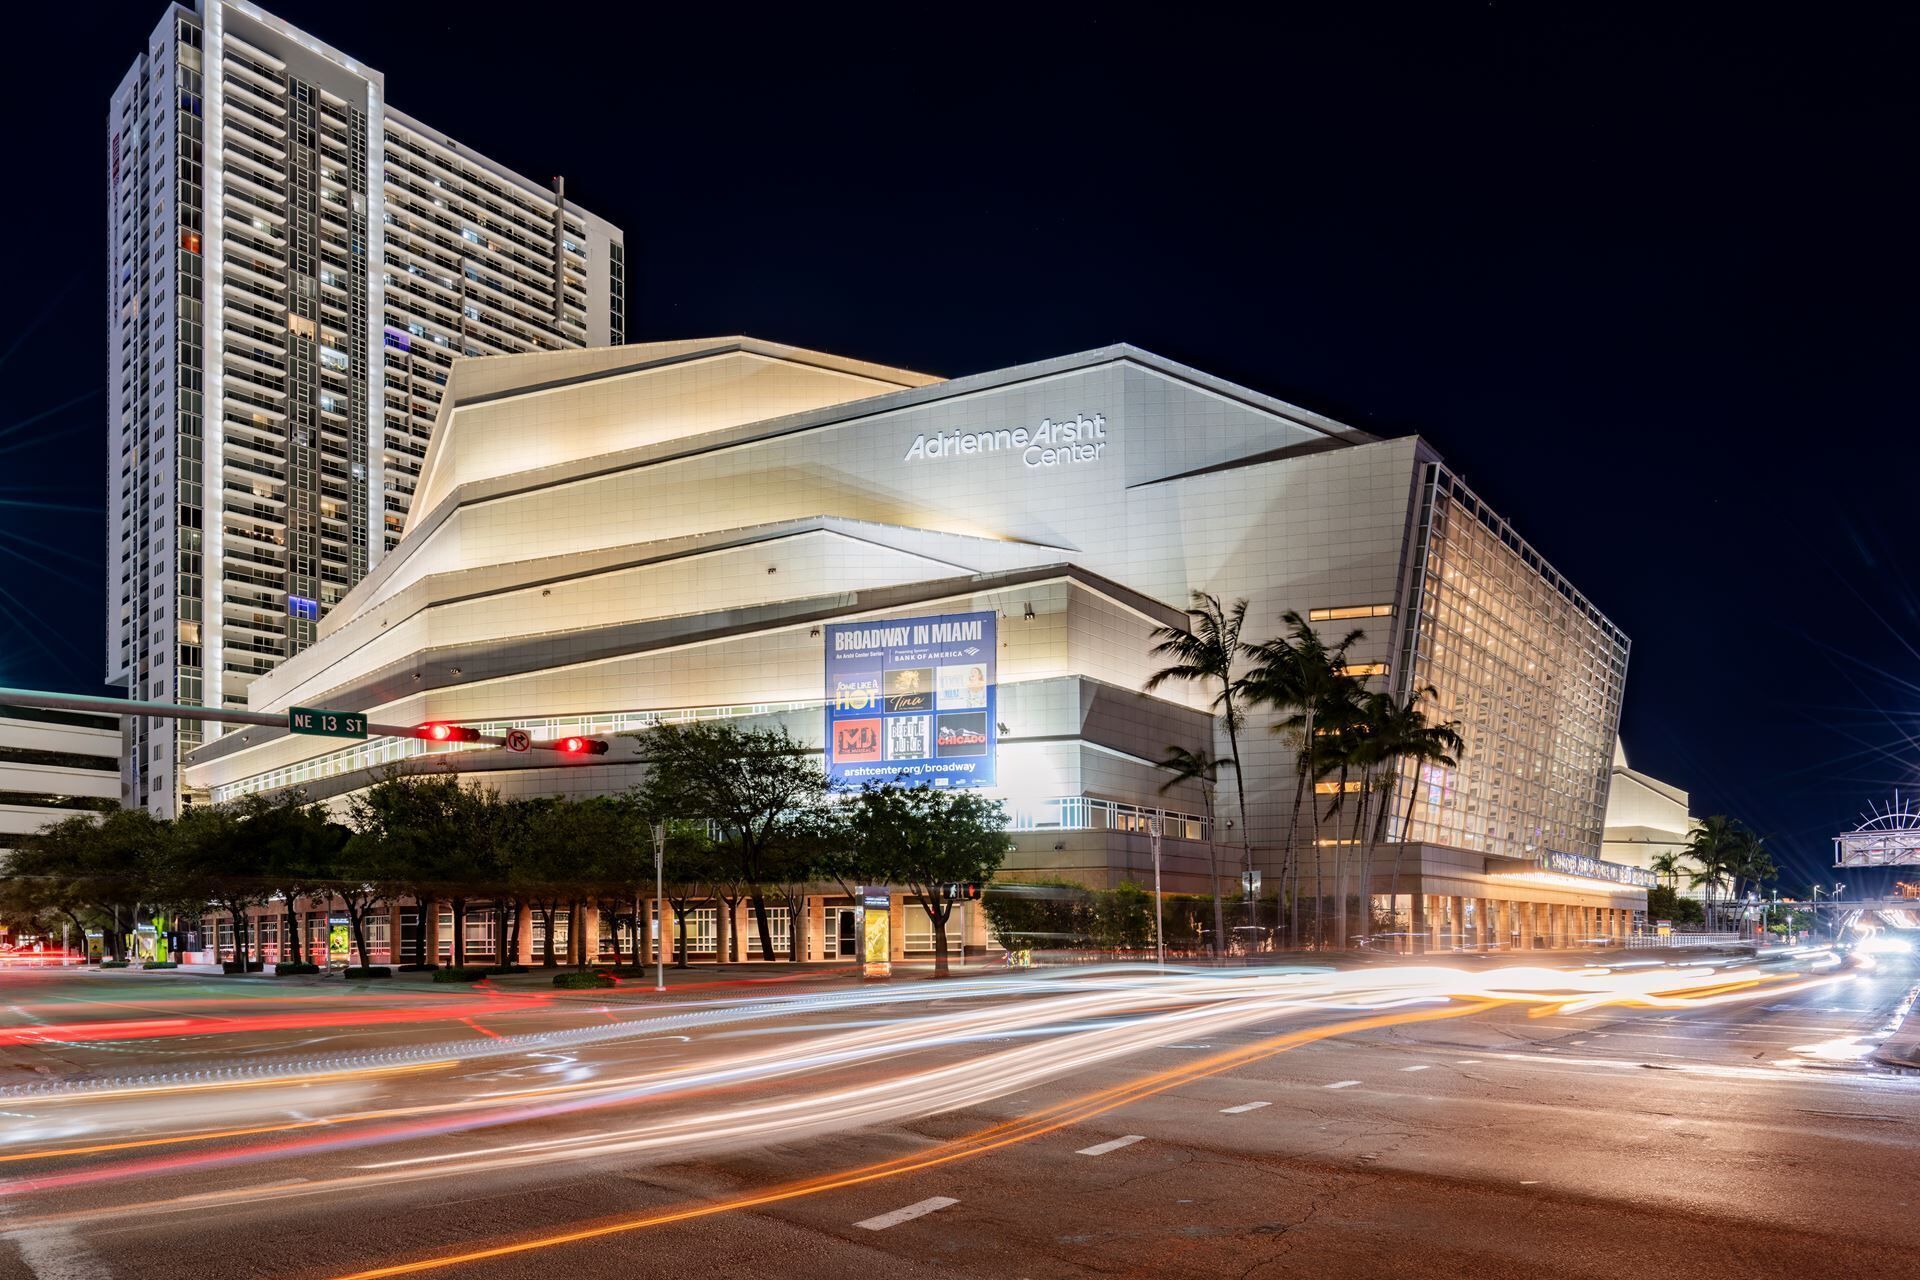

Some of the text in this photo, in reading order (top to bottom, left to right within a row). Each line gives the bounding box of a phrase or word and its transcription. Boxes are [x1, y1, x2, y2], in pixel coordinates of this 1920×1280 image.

[904, 413, 1106, 461] Adrienne Arsht
[1023, 441, 1106, 468] Center
[835, 620, 982, 651] BROADWAY IN MIAMI
[895, 654, 916, 662] BANK
[928, 651, 963, 660] AMERICA
[835, 689, 879, 711] HOT
[890, 695, 926, 711] Tina
[295, 714, 363, 732] NE 13 ST
[842, 728, 872, 749] MJ
